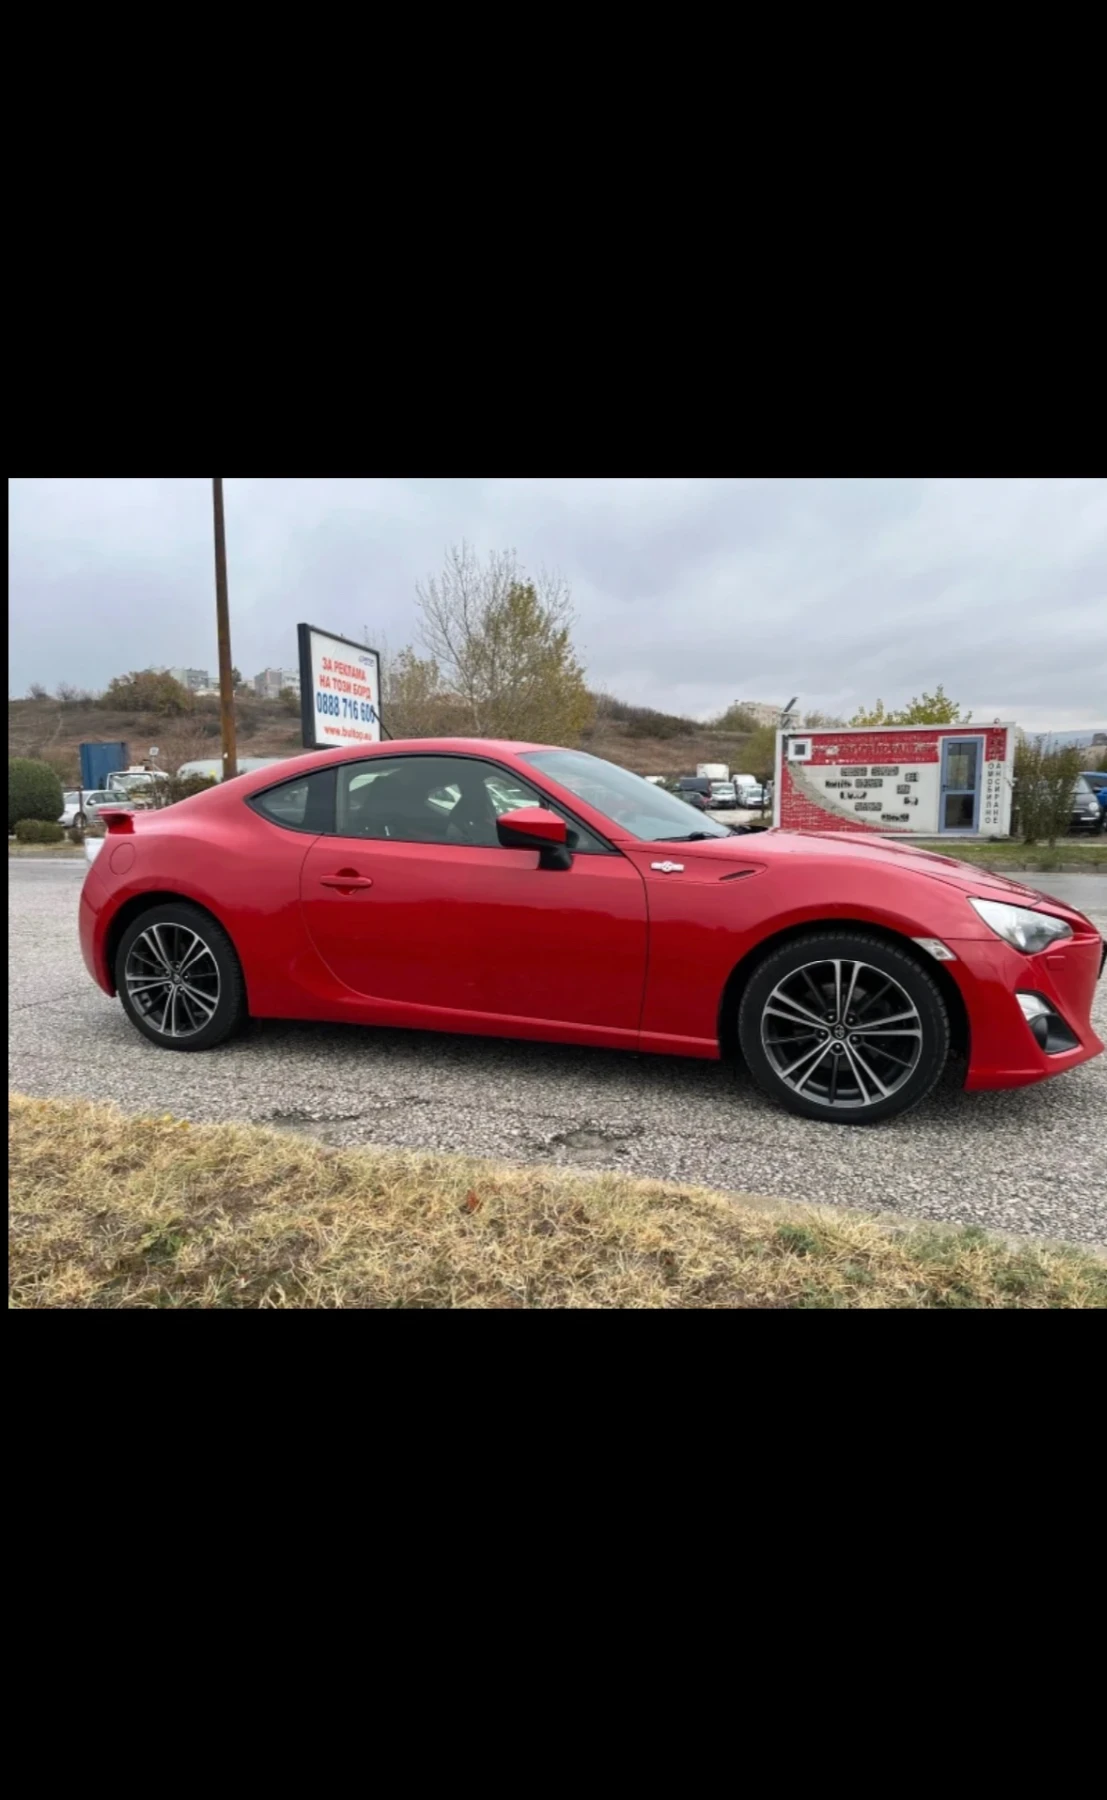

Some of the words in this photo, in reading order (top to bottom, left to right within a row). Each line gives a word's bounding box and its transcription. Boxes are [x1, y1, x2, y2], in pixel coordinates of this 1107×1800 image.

[322, 657, 332, 670] ЗА
[334, 660, 366, 681] РЕКЛАМА
[319, 674, 331, 689] НА
[332, 678, 352, 694] ТОЗИ
[353, 683, 371, 699] БОРД
[316, 691, 340, 717] 0888
[342, 698, 358, 720] 716
